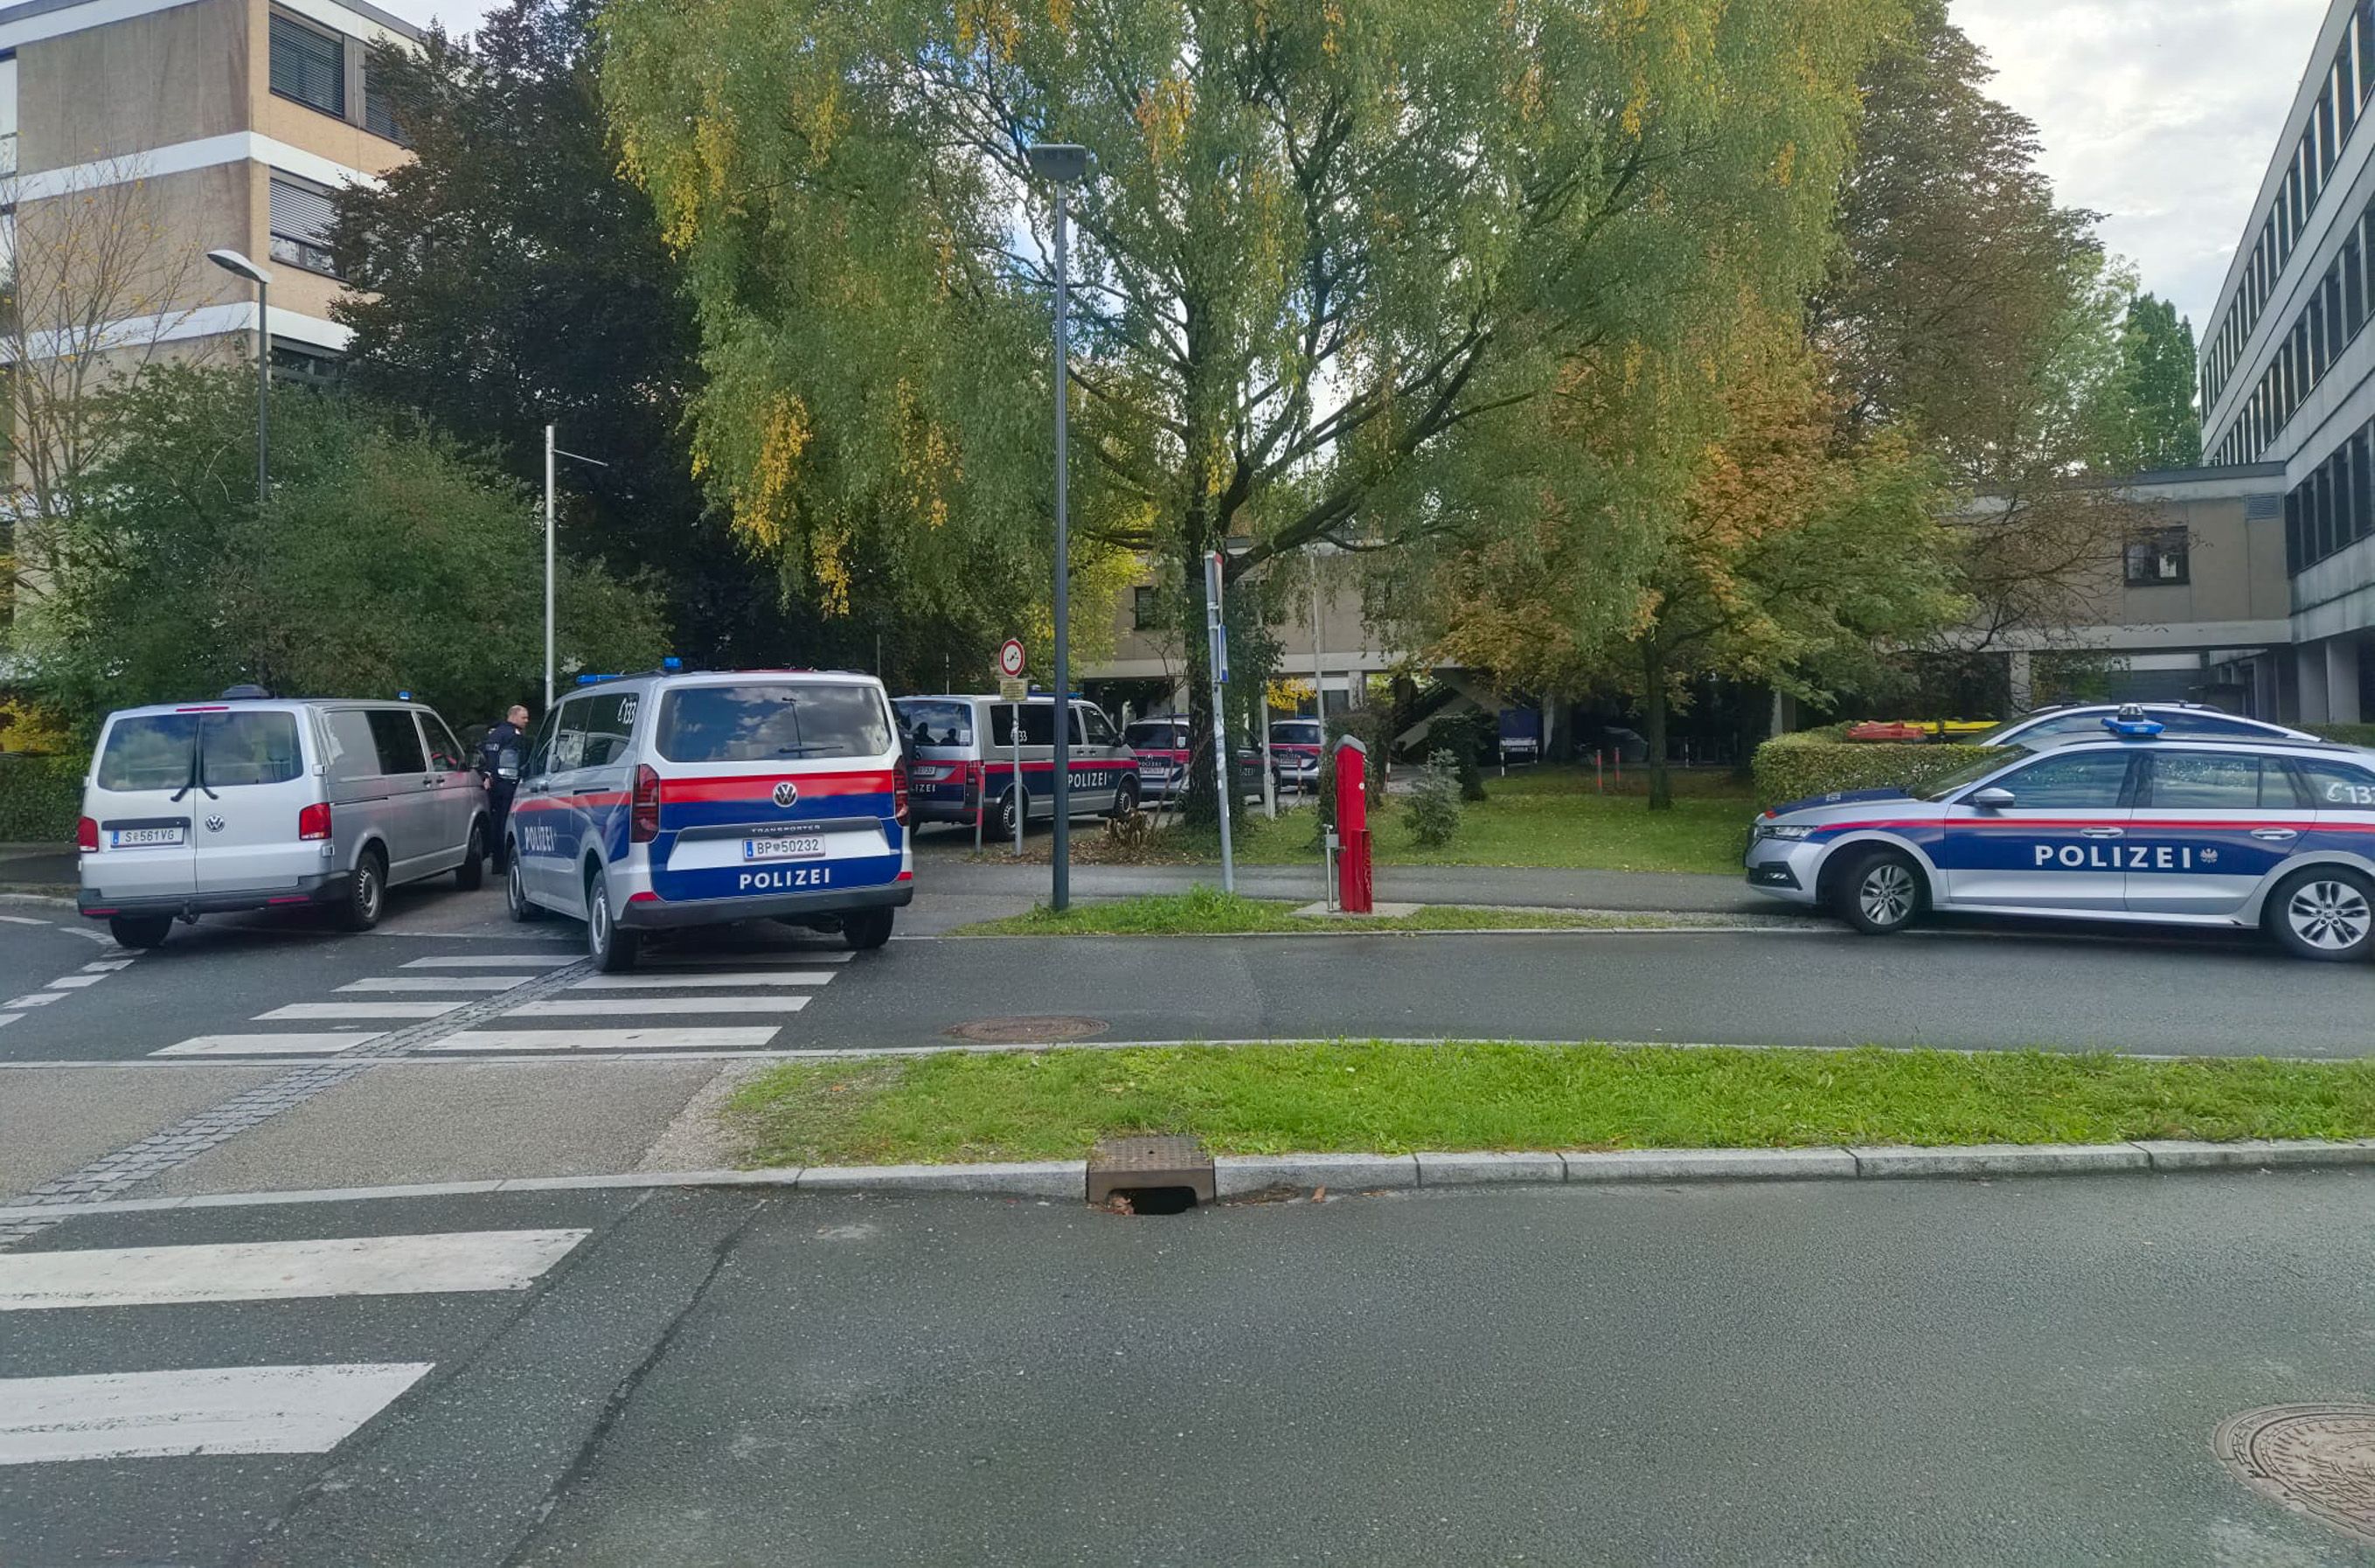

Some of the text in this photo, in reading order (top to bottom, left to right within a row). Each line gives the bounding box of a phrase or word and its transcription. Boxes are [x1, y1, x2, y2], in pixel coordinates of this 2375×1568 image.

[623, 702, 636, 724] 133
[914, 783, 935, 793] IZEI
[1068, 772, 1107, 787] POLIZEI
[524, 826, 555, 851] POLIZEI
[2035, 845, 2191, 868] POLIZEI
[740, 868, 830, 890] POLIZEI
